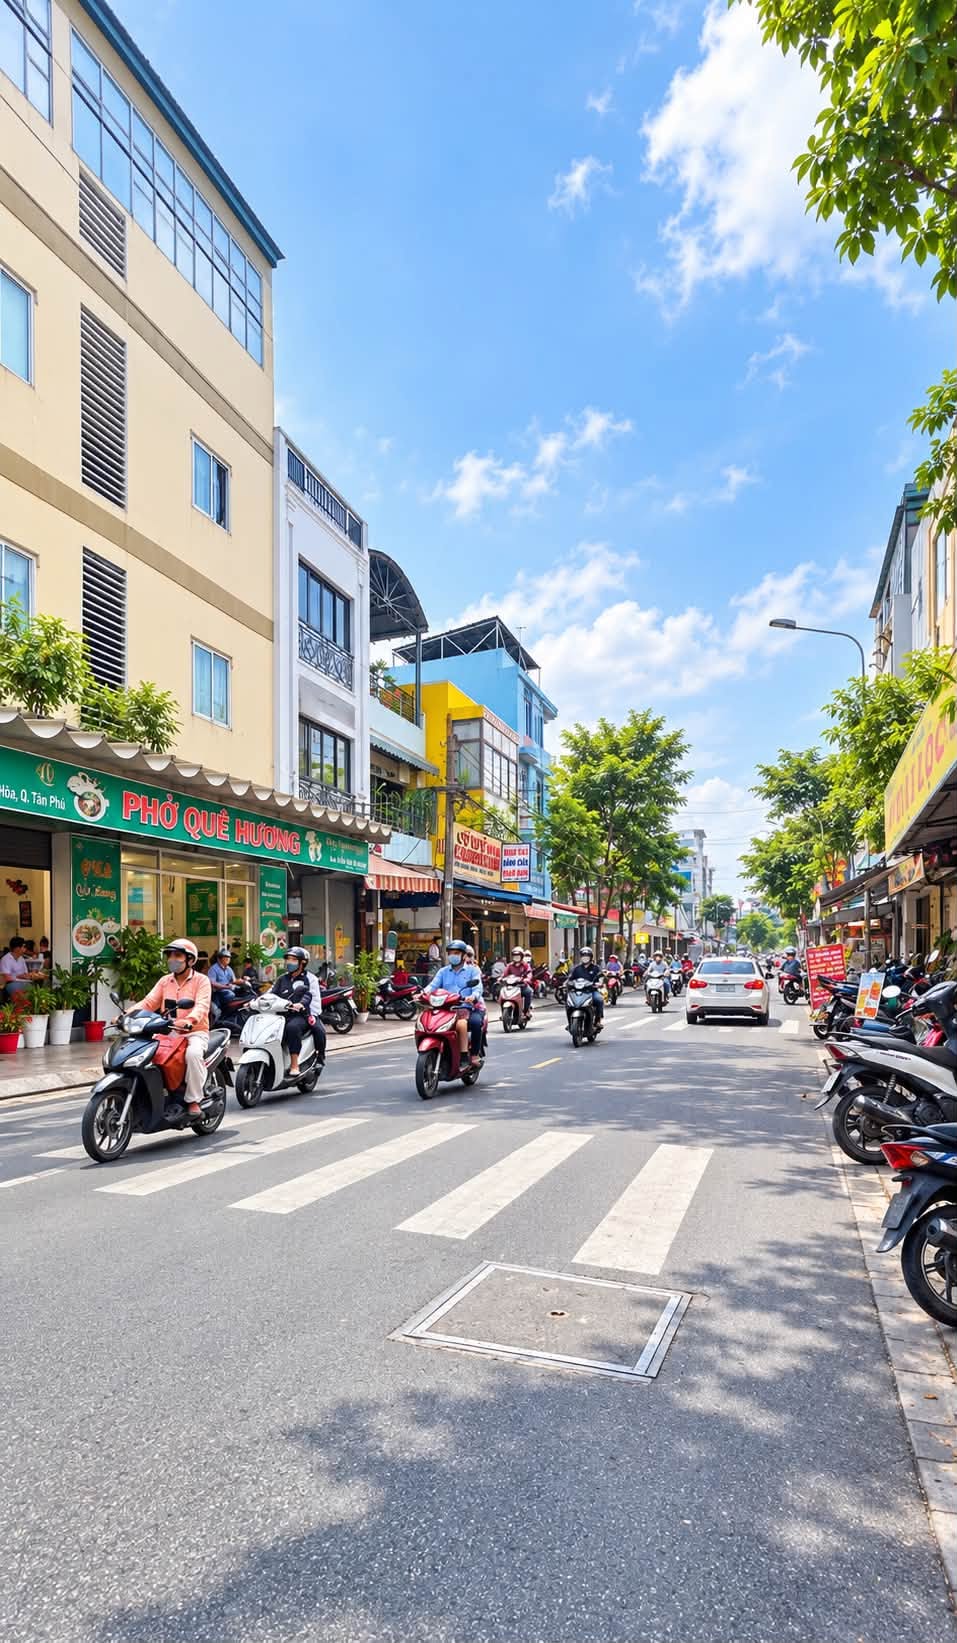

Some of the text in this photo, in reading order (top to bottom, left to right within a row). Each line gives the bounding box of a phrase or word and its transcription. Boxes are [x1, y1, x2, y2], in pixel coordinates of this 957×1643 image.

[20, 789, 30, 804] Q.
[31, 792, 48, 807] Tân
[122, 790, 179, 830] PHỞ
[183, 807, 230, 840] QUÊ
[235, 818, 301, 855] HƯƠNG
